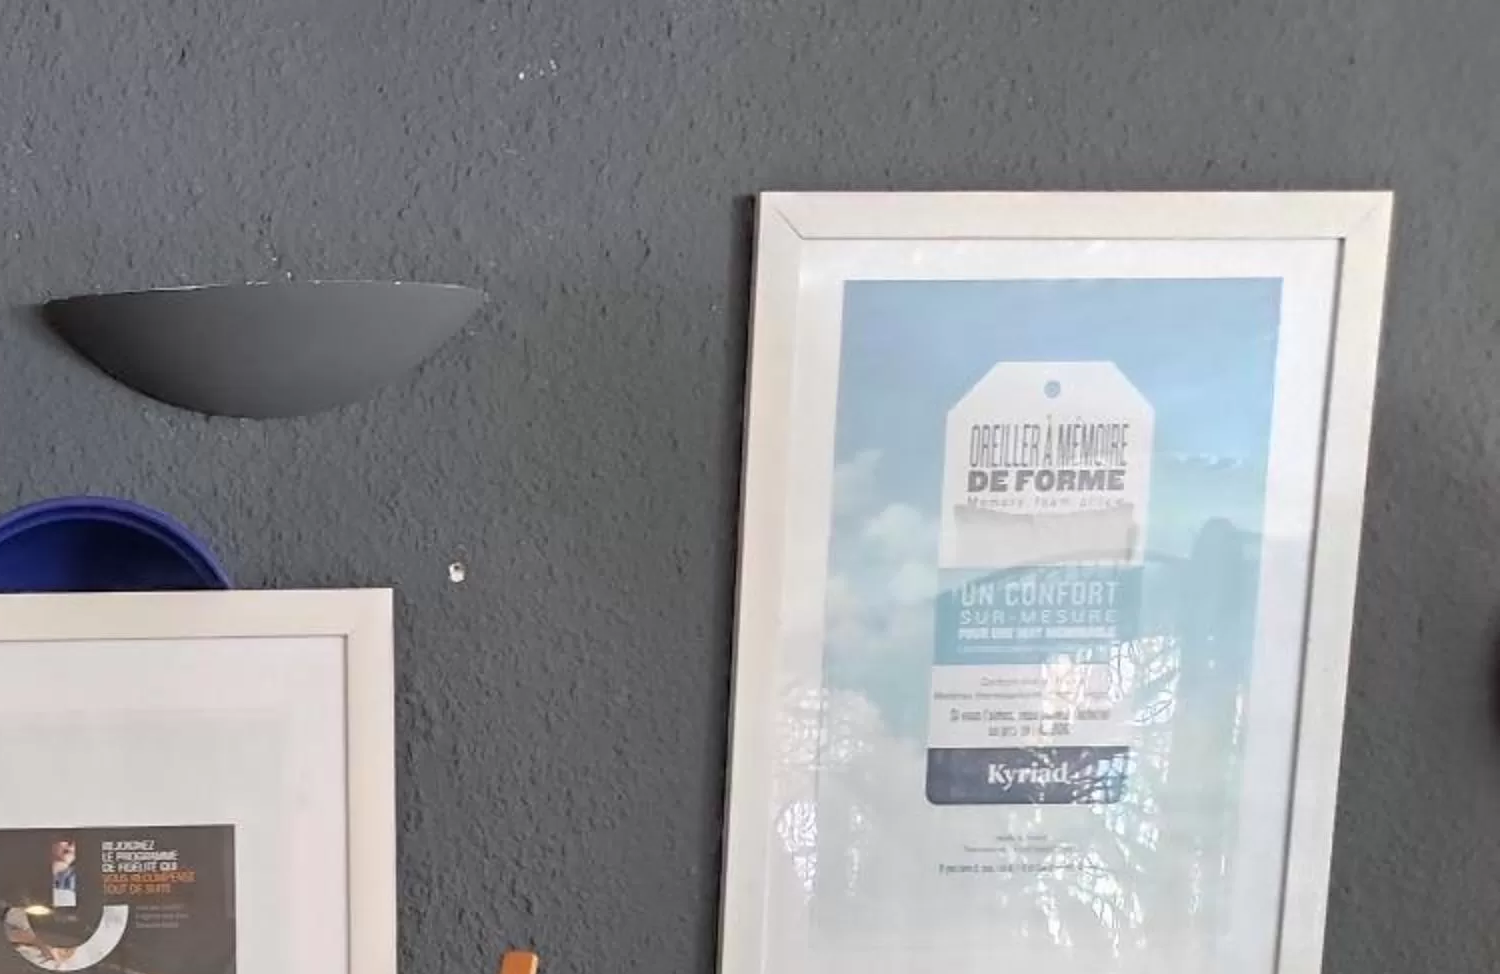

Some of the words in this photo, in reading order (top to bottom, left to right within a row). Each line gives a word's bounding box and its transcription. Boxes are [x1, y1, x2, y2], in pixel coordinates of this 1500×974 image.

[970, 424, 1040, 467] OREILLER
[967, 470, 1009, 492] DE
[1015, 469, 1127, 492] FORME
[961, 582, 995, 607] UN
[1004, 581, 1120, 607] CONFORT
[959, 608, 1118, 625] SUR-MESURE
[987, 762, 1070, 791] Kyriad
